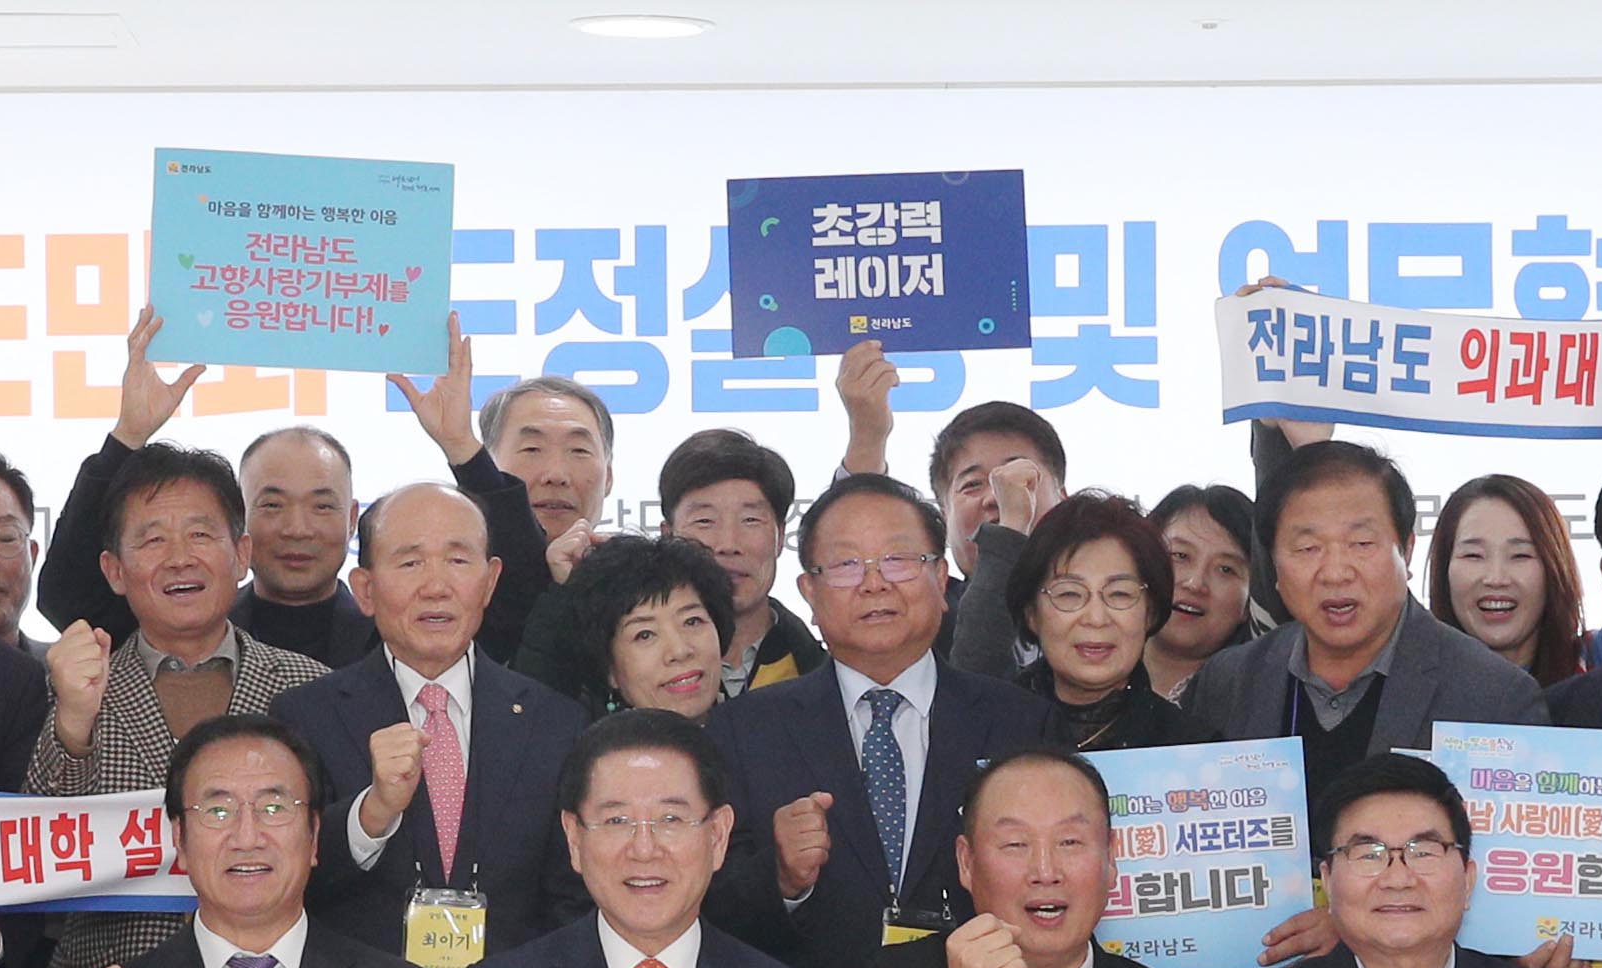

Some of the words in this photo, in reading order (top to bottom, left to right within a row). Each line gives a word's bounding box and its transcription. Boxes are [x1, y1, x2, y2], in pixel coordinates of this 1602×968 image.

[208, 201, 251, 218] 마음을
[257, 203, 315, 221] 함께하는
[321, 206, 365, 224] 행복한
[370, 209, 398, 225] 이음
[812, 200, 942, 246] 초강력
[245, 233, 358, 264] 전라남도
[190, 264, 410, 303] 고향사랑기부제를
[814, 253, 945, 299] 레이저
[224, 299, 374, 333] 응원합니다!
[870, 316, 913, 330] 전라남도
[1029, 220, 1159, 409] 및
[1248, 307, 1432, 395] 전라남도
[1471, 769, 1533, 792] 마음을
[1109, 794, 1164, 816] 께하는
[1166, 789, 1227, 812] 행복한
[1230, 787, 1267, 808] 이음
[1175, 815, 1294, 853] 서포터즈를
[1101, 865, 1270, 916] 원합니다
[421, 931, 470, 950] 최이기
[1125, 938, 1198, 958] 전라남도
